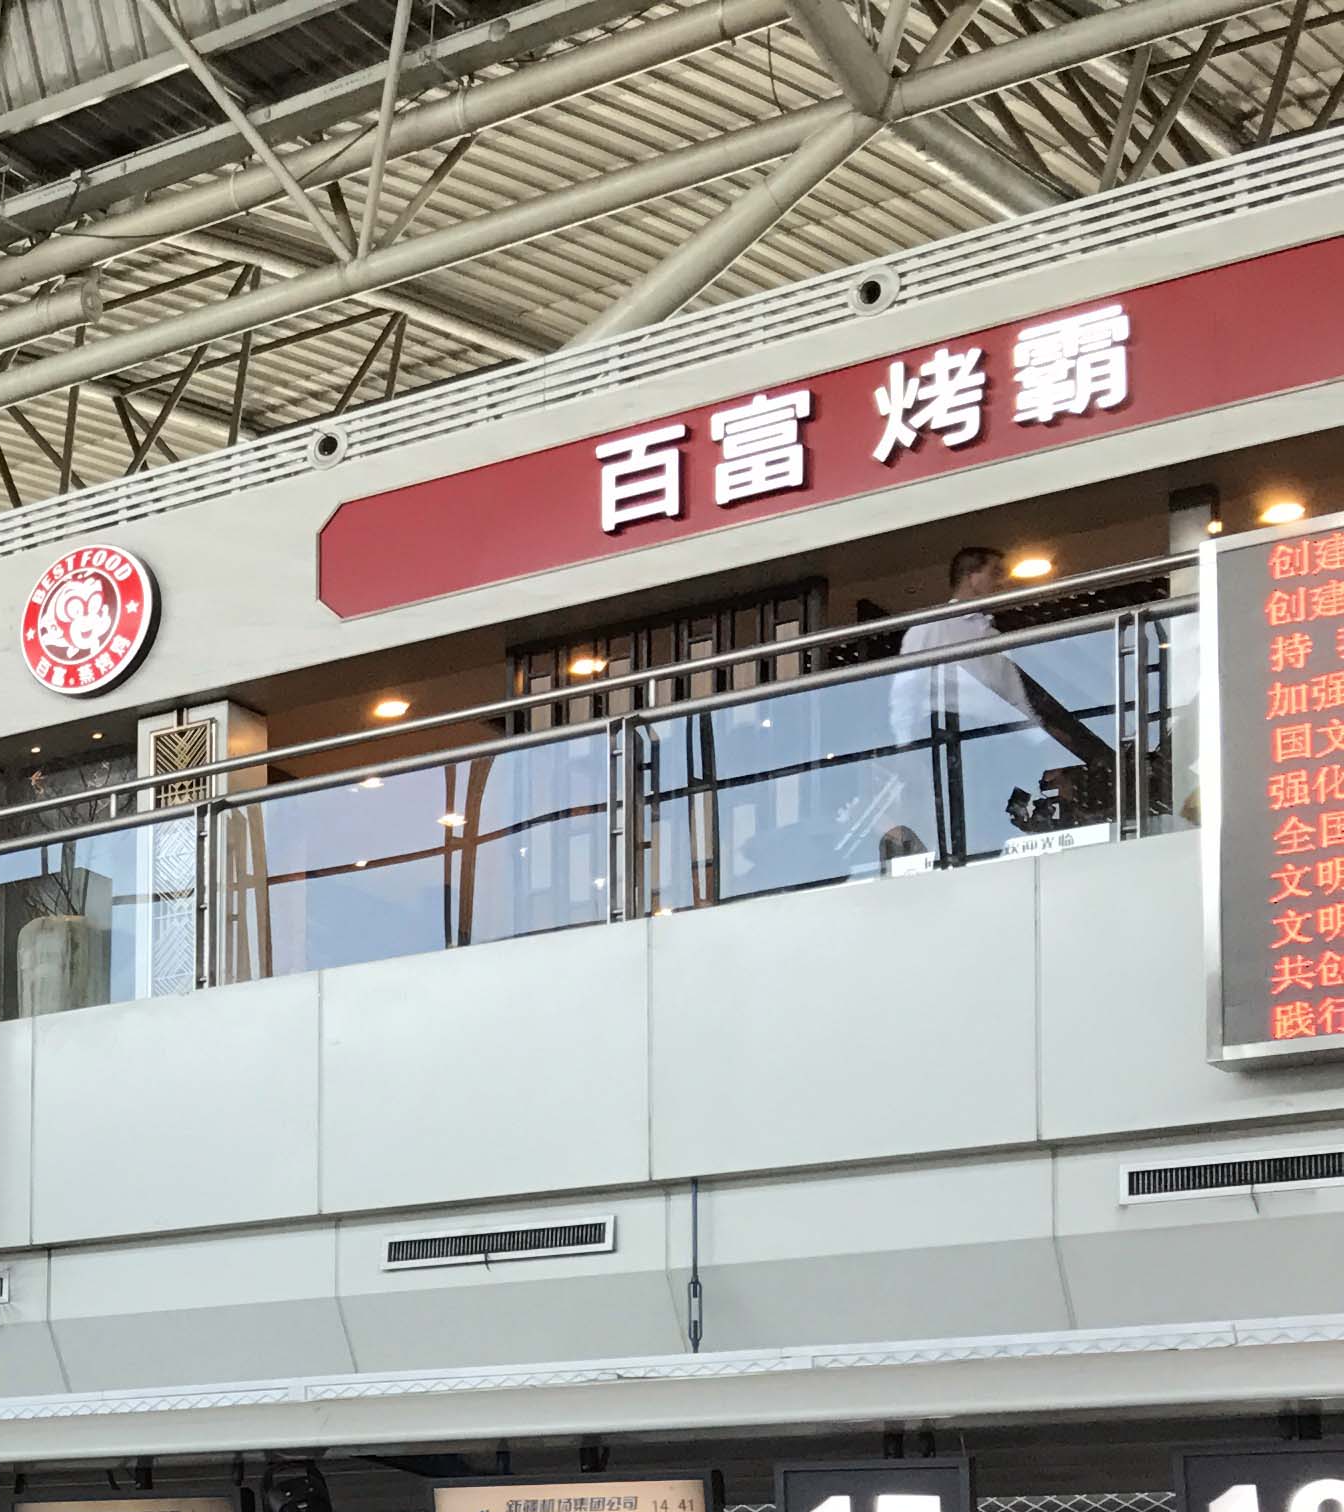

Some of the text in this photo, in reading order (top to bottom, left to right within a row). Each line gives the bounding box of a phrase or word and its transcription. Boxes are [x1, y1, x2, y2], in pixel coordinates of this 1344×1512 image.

[594, 303, 1130, 535] 百富 烤霸
[32, 550, 133, 605] BEST FOOD
[1270, 632, 1313, 672] 持
